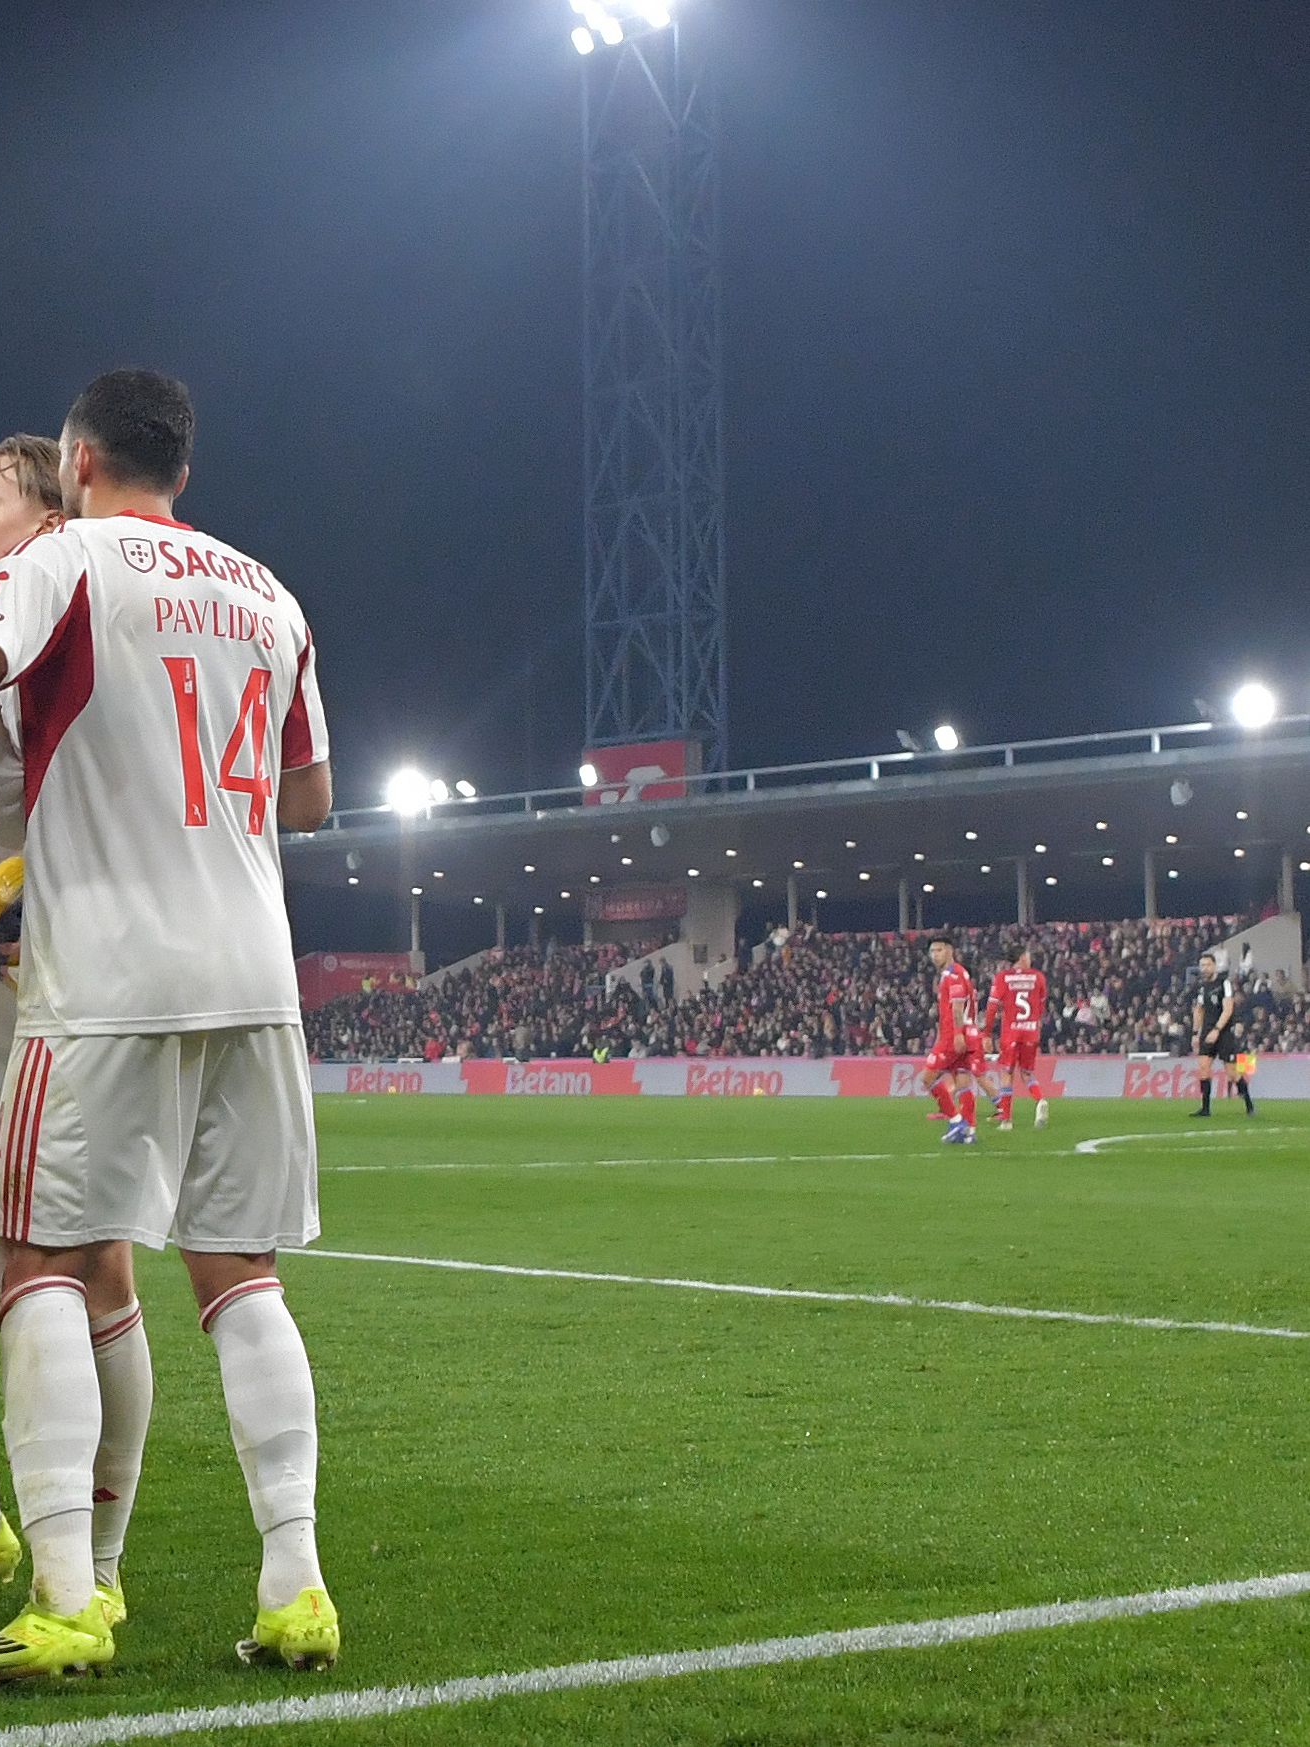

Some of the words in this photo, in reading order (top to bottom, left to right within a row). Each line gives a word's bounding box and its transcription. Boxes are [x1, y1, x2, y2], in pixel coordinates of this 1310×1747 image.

[157, 541, 276, 603] SAGRES
[153, 597, 275, 651] PAVLIDIS
[160, 656, 273, 836] 14
[1015, 991, 1031, 1021] 5
[346, 1066, 423, 1093] Betano
[505, 1064, 592, 1095] Betano
[686, 1064, 783, 1096] Betano
